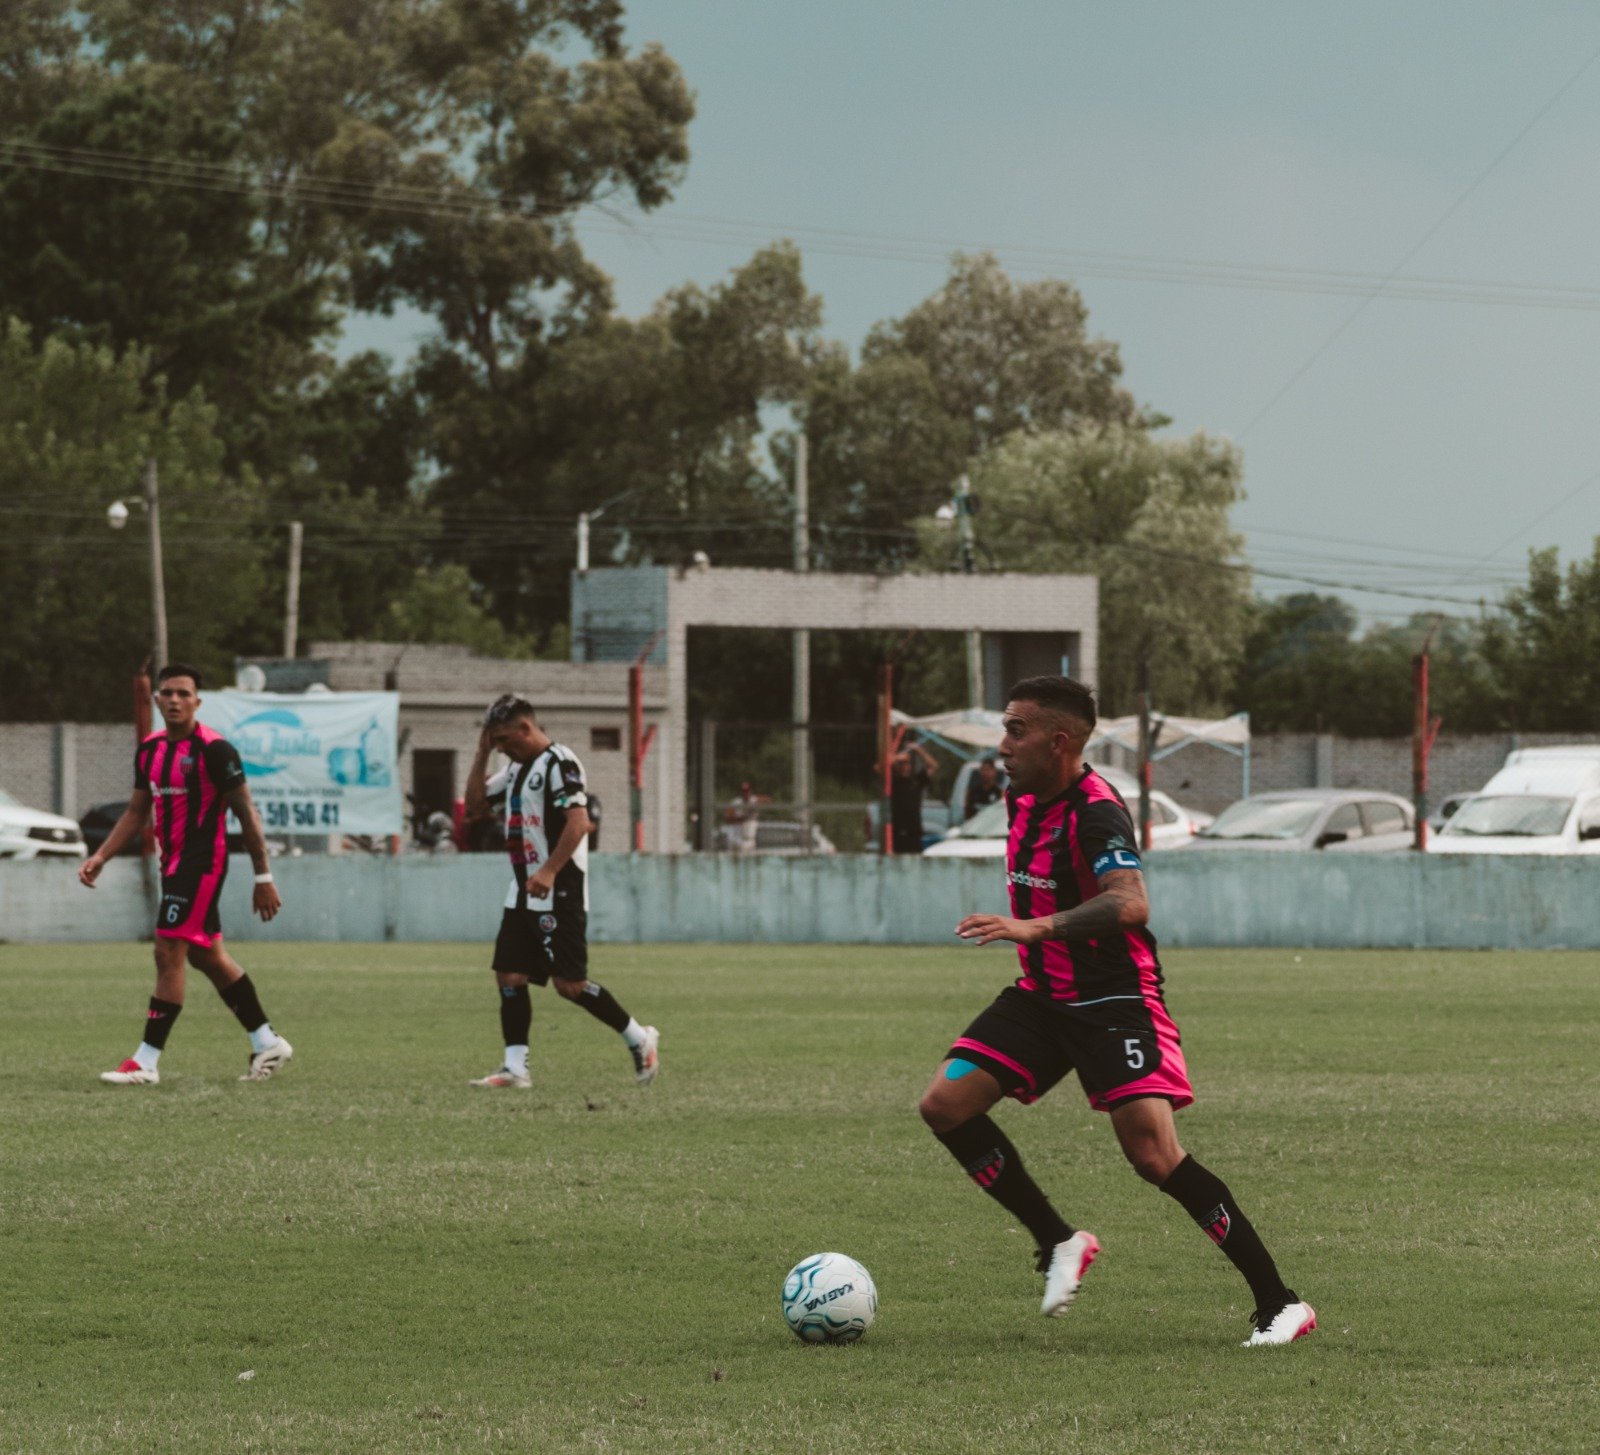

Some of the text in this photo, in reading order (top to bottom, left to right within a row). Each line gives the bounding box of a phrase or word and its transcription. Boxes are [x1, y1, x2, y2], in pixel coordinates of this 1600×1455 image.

[266, 802, 288, 826] 50
[293, 802, 315, 826] 50
[321, 803, 339, 824] 41
[167, 904, 180, 923] 6
[1124, 1039, 1144, 1069] 5
[804, 1282, 854, 1311] KAGIVA
